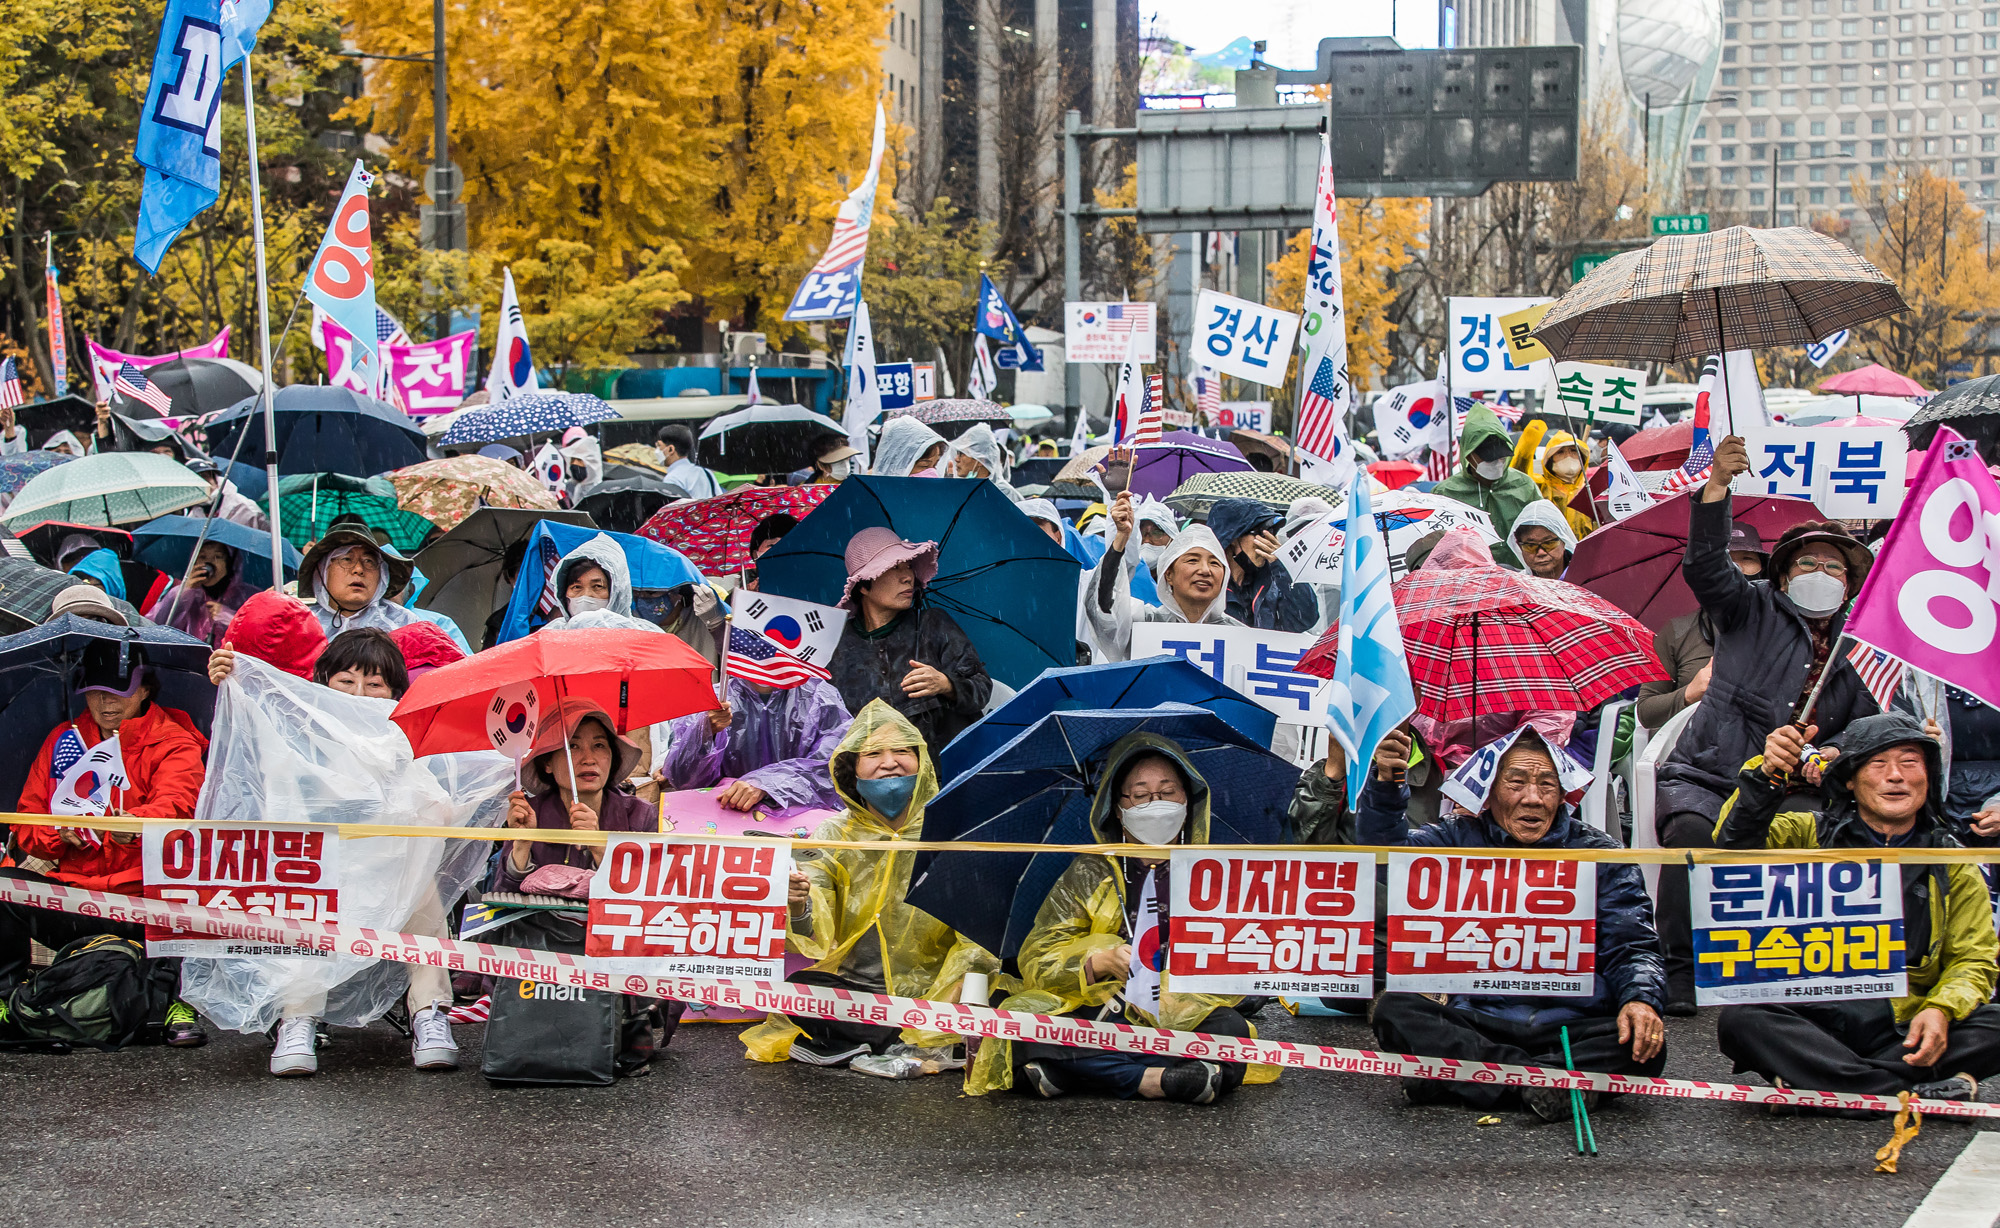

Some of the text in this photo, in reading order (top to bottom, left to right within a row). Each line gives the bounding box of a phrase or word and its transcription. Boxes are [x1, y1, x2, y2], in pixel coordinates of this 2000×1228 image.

[1207, 304, 1279, 369] 경산
[877, 372, 911, 397] 포항
[920, 372, 927, 393] 1
[1557, 371, 1637, 417] 속초
[1759, 441, 1886, 504] 전북
[163, 828, 325, 884] 이재명
[608, 841, 776, 901] 이재명
[1189, 858, 1359, 917] 이재명
[1406, 856, 1578, 915] 이재명
[1709, 859, 1882, 922] 문재인
[591, 903, 787, 957] 구속하라
[1173, 921, 1375, 973] 구속하라
[1390, 920, 1595, 971] 구속하라
[1698, 924, 1906, 978] 구속하라
[668, 963, 772, 977] #주사파척결범국민대회
[1253, 981, 1360, 994] #주사파척결범국민대회
[1472, 979, 1581, 992] #주사파척결범국민대회
[1784, 982, 1894, 997] #주사파척결범국민대회
